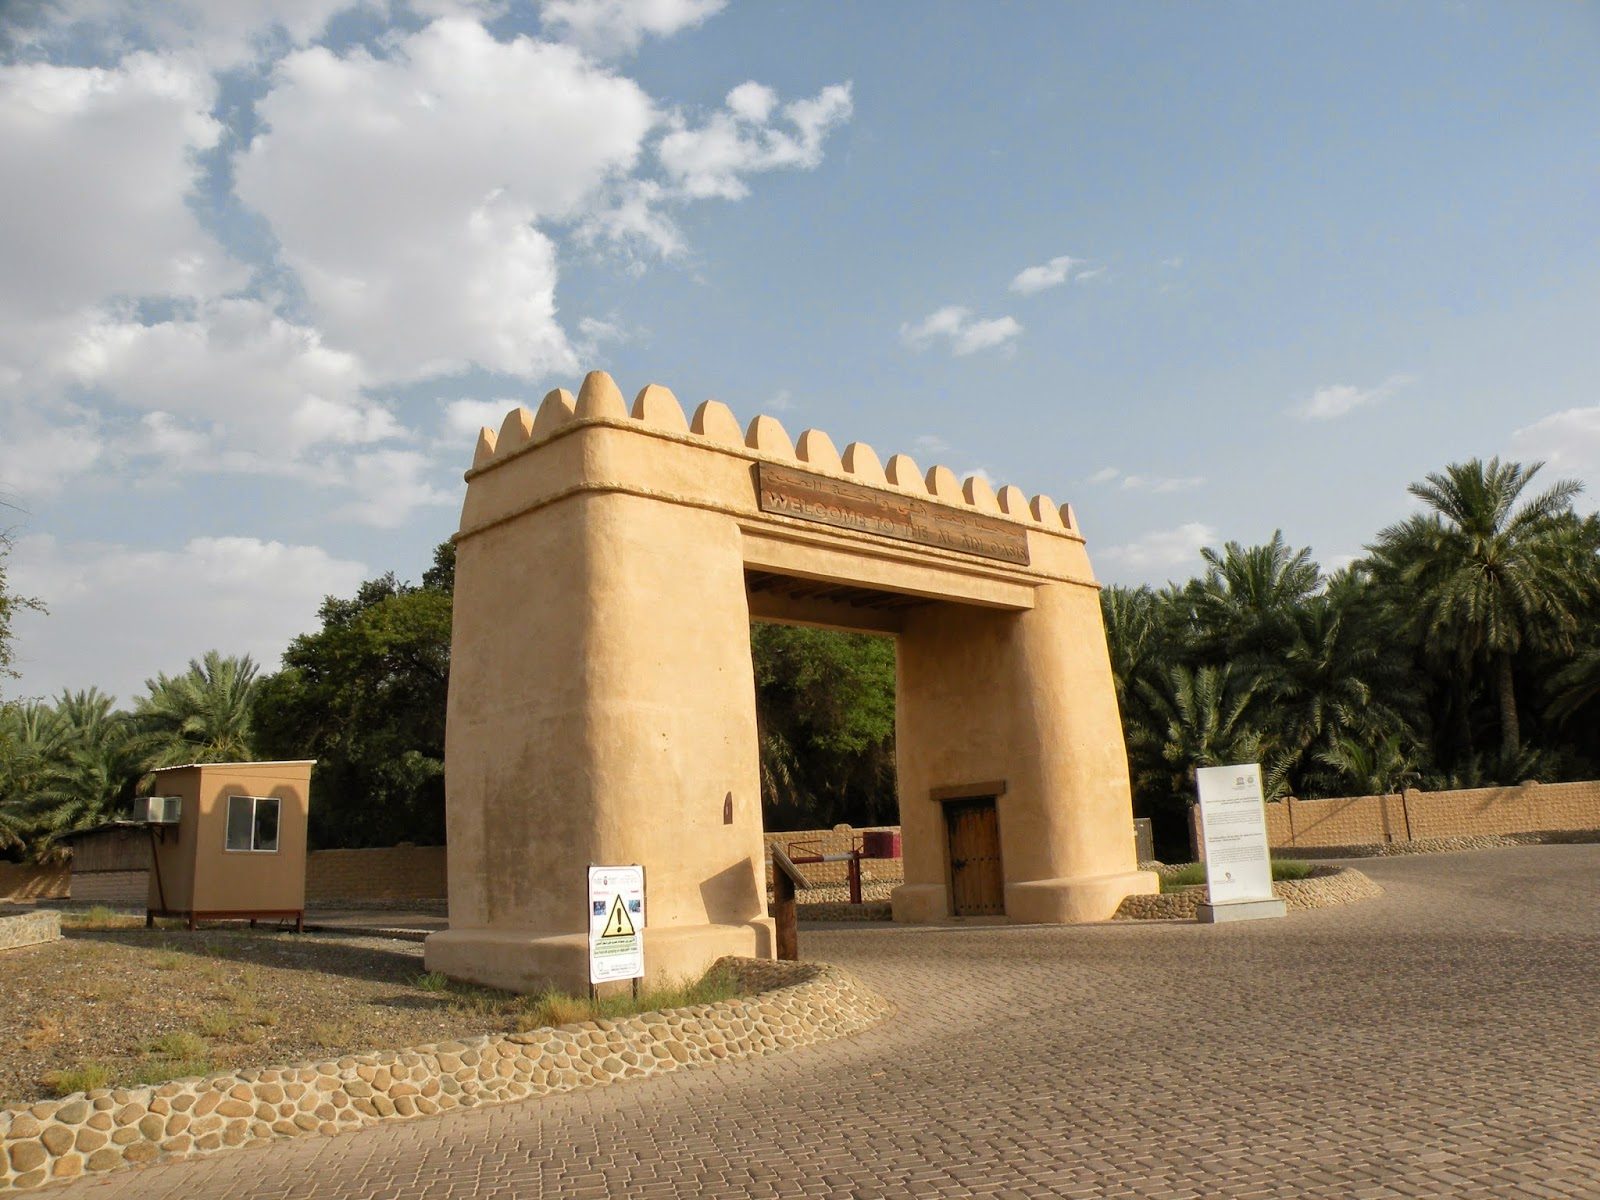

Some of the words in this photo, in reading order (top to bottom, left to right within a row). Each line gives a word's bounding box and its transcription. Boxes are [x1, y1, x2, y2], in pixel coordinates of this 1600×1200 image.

[765, 490, 867, 526] WELCOME
[872, 515, 896, 532] TO
[903, 521, 929, 539] THE
[937, 529, 954, 545] AL
[962, 534, 985, 552] AIN
[990, 541, 1028, 560] OASIS
